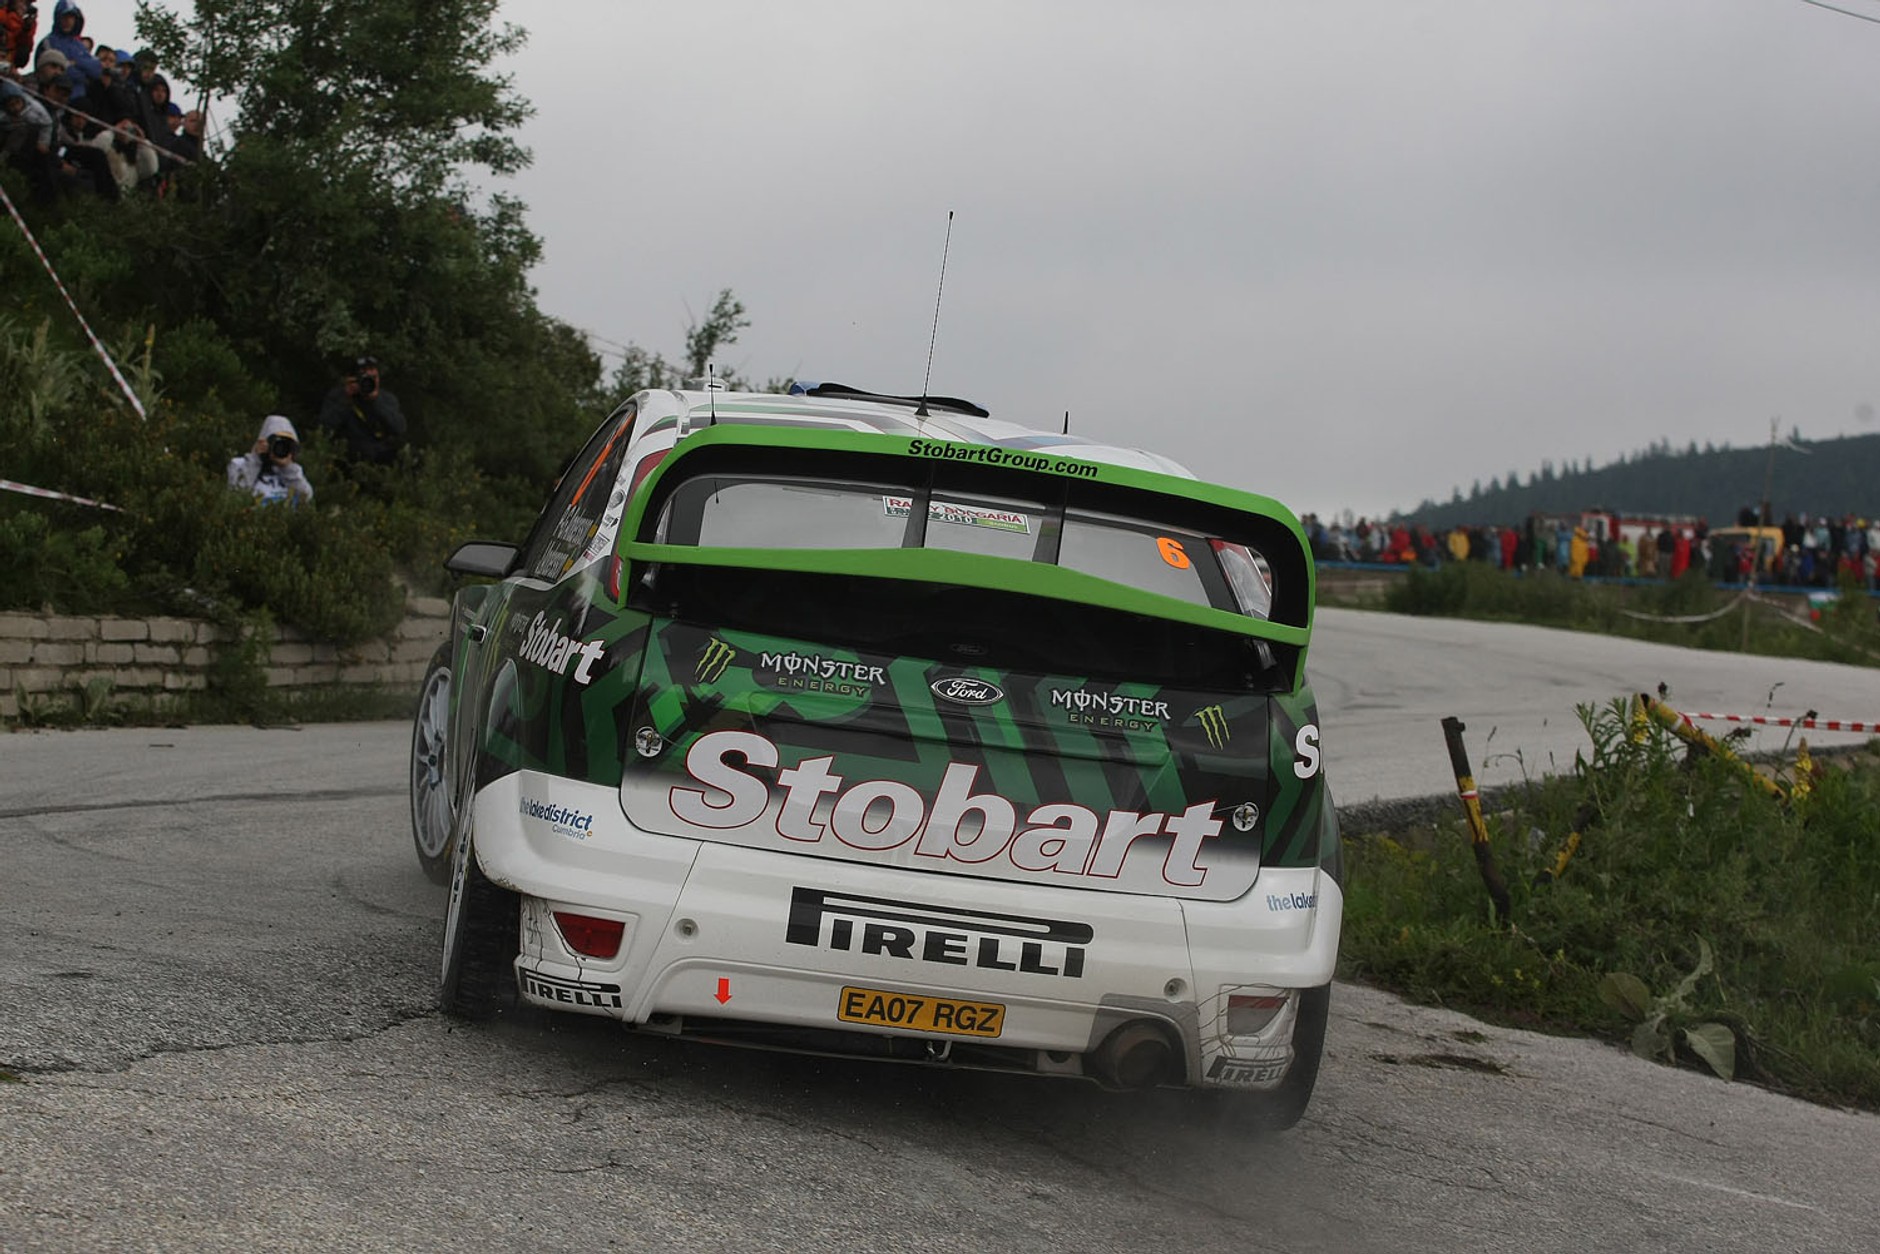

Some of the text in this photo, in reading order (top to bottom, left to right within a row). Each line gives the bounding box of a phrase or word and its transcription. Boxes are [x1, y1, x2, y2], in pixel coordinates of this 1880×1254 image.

[908, 439, 1098, 478] StobartGroup.com
[889, 499, 939, 511] RAY
[944, 506, 1022, 523] BULGARIA
[1156, 537, 1191, 570] 6
[519, 610, 605, 685] Stobart
[778, 677, 867, 697] ENERGY
[946, 680, 989, 699] Ford
[1070, 714, 1154, 731] ENERGY
[1293, 724, 1322, 779] S
[669, 729, 1224, 887] Stobart
[785, 885, 1095, 979] PIRELLI
[518, 965, 622, 1009] PIRELLI
[844, 991, 999, 1033] EA07 RGZ
